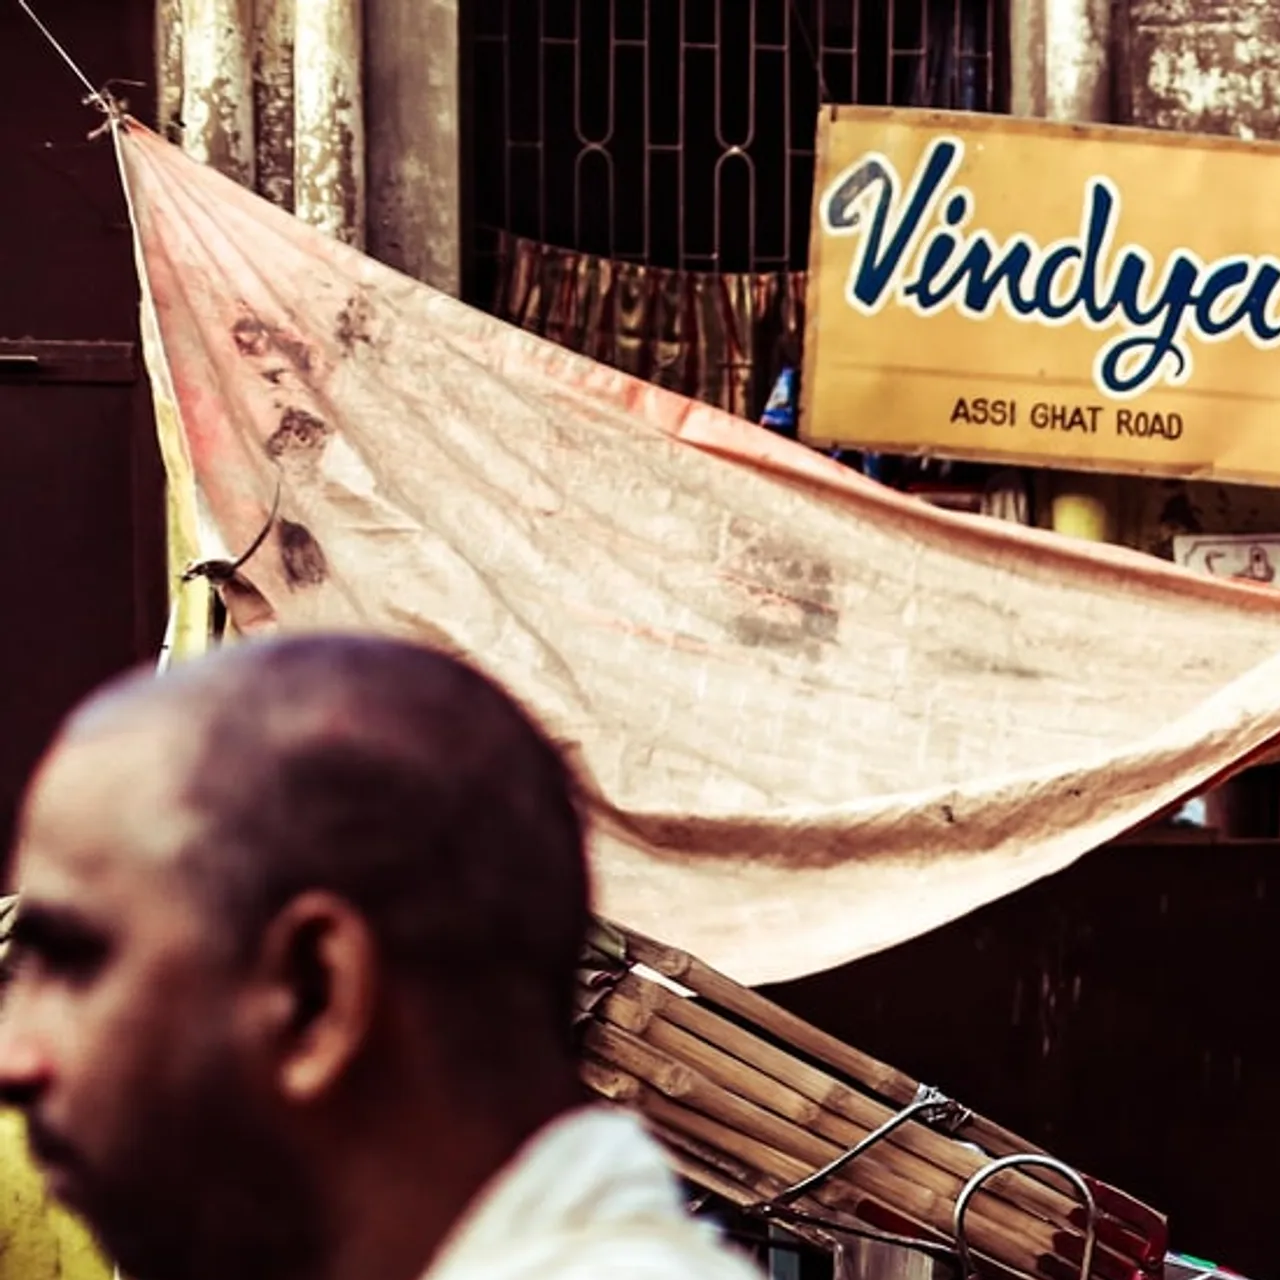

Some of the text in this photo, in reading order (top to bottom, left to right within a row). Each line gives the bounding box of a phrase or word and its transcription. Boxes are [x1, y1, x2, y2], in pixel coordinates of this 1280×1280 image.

[950, 397, 1183, 440] ASSI GHAT ROAD
